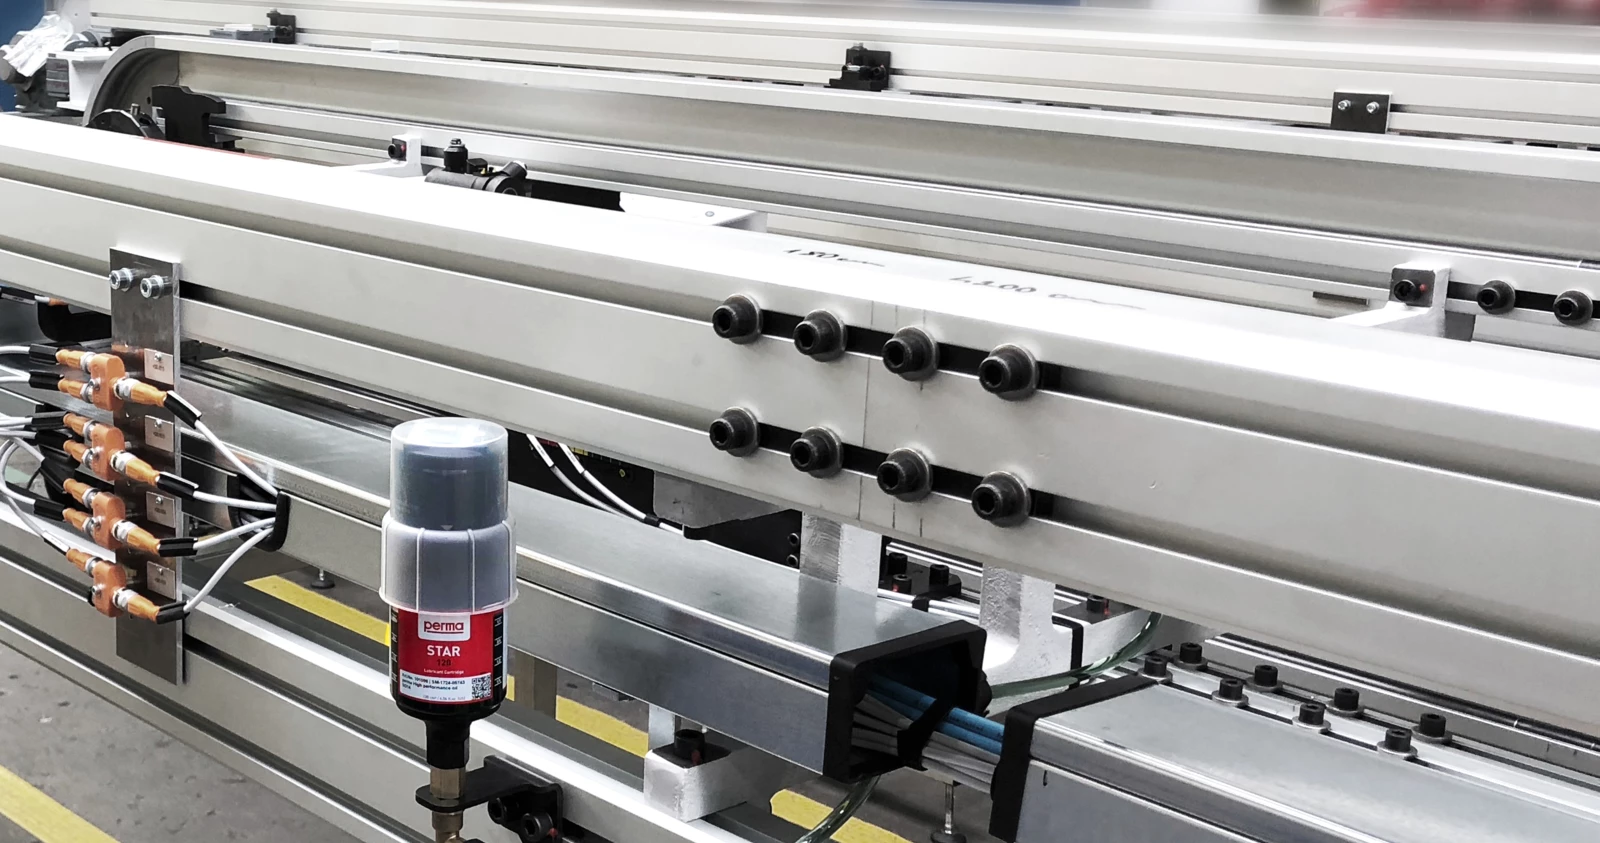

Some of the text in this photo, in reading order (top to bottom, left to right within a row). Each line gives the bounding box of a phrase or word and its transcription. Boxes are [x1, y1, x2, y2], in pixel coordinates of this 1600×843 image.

[423, 621, 464, 633] perma
[426, 645, 461, 657] STAR
[436, 659, 452, 667] 120
